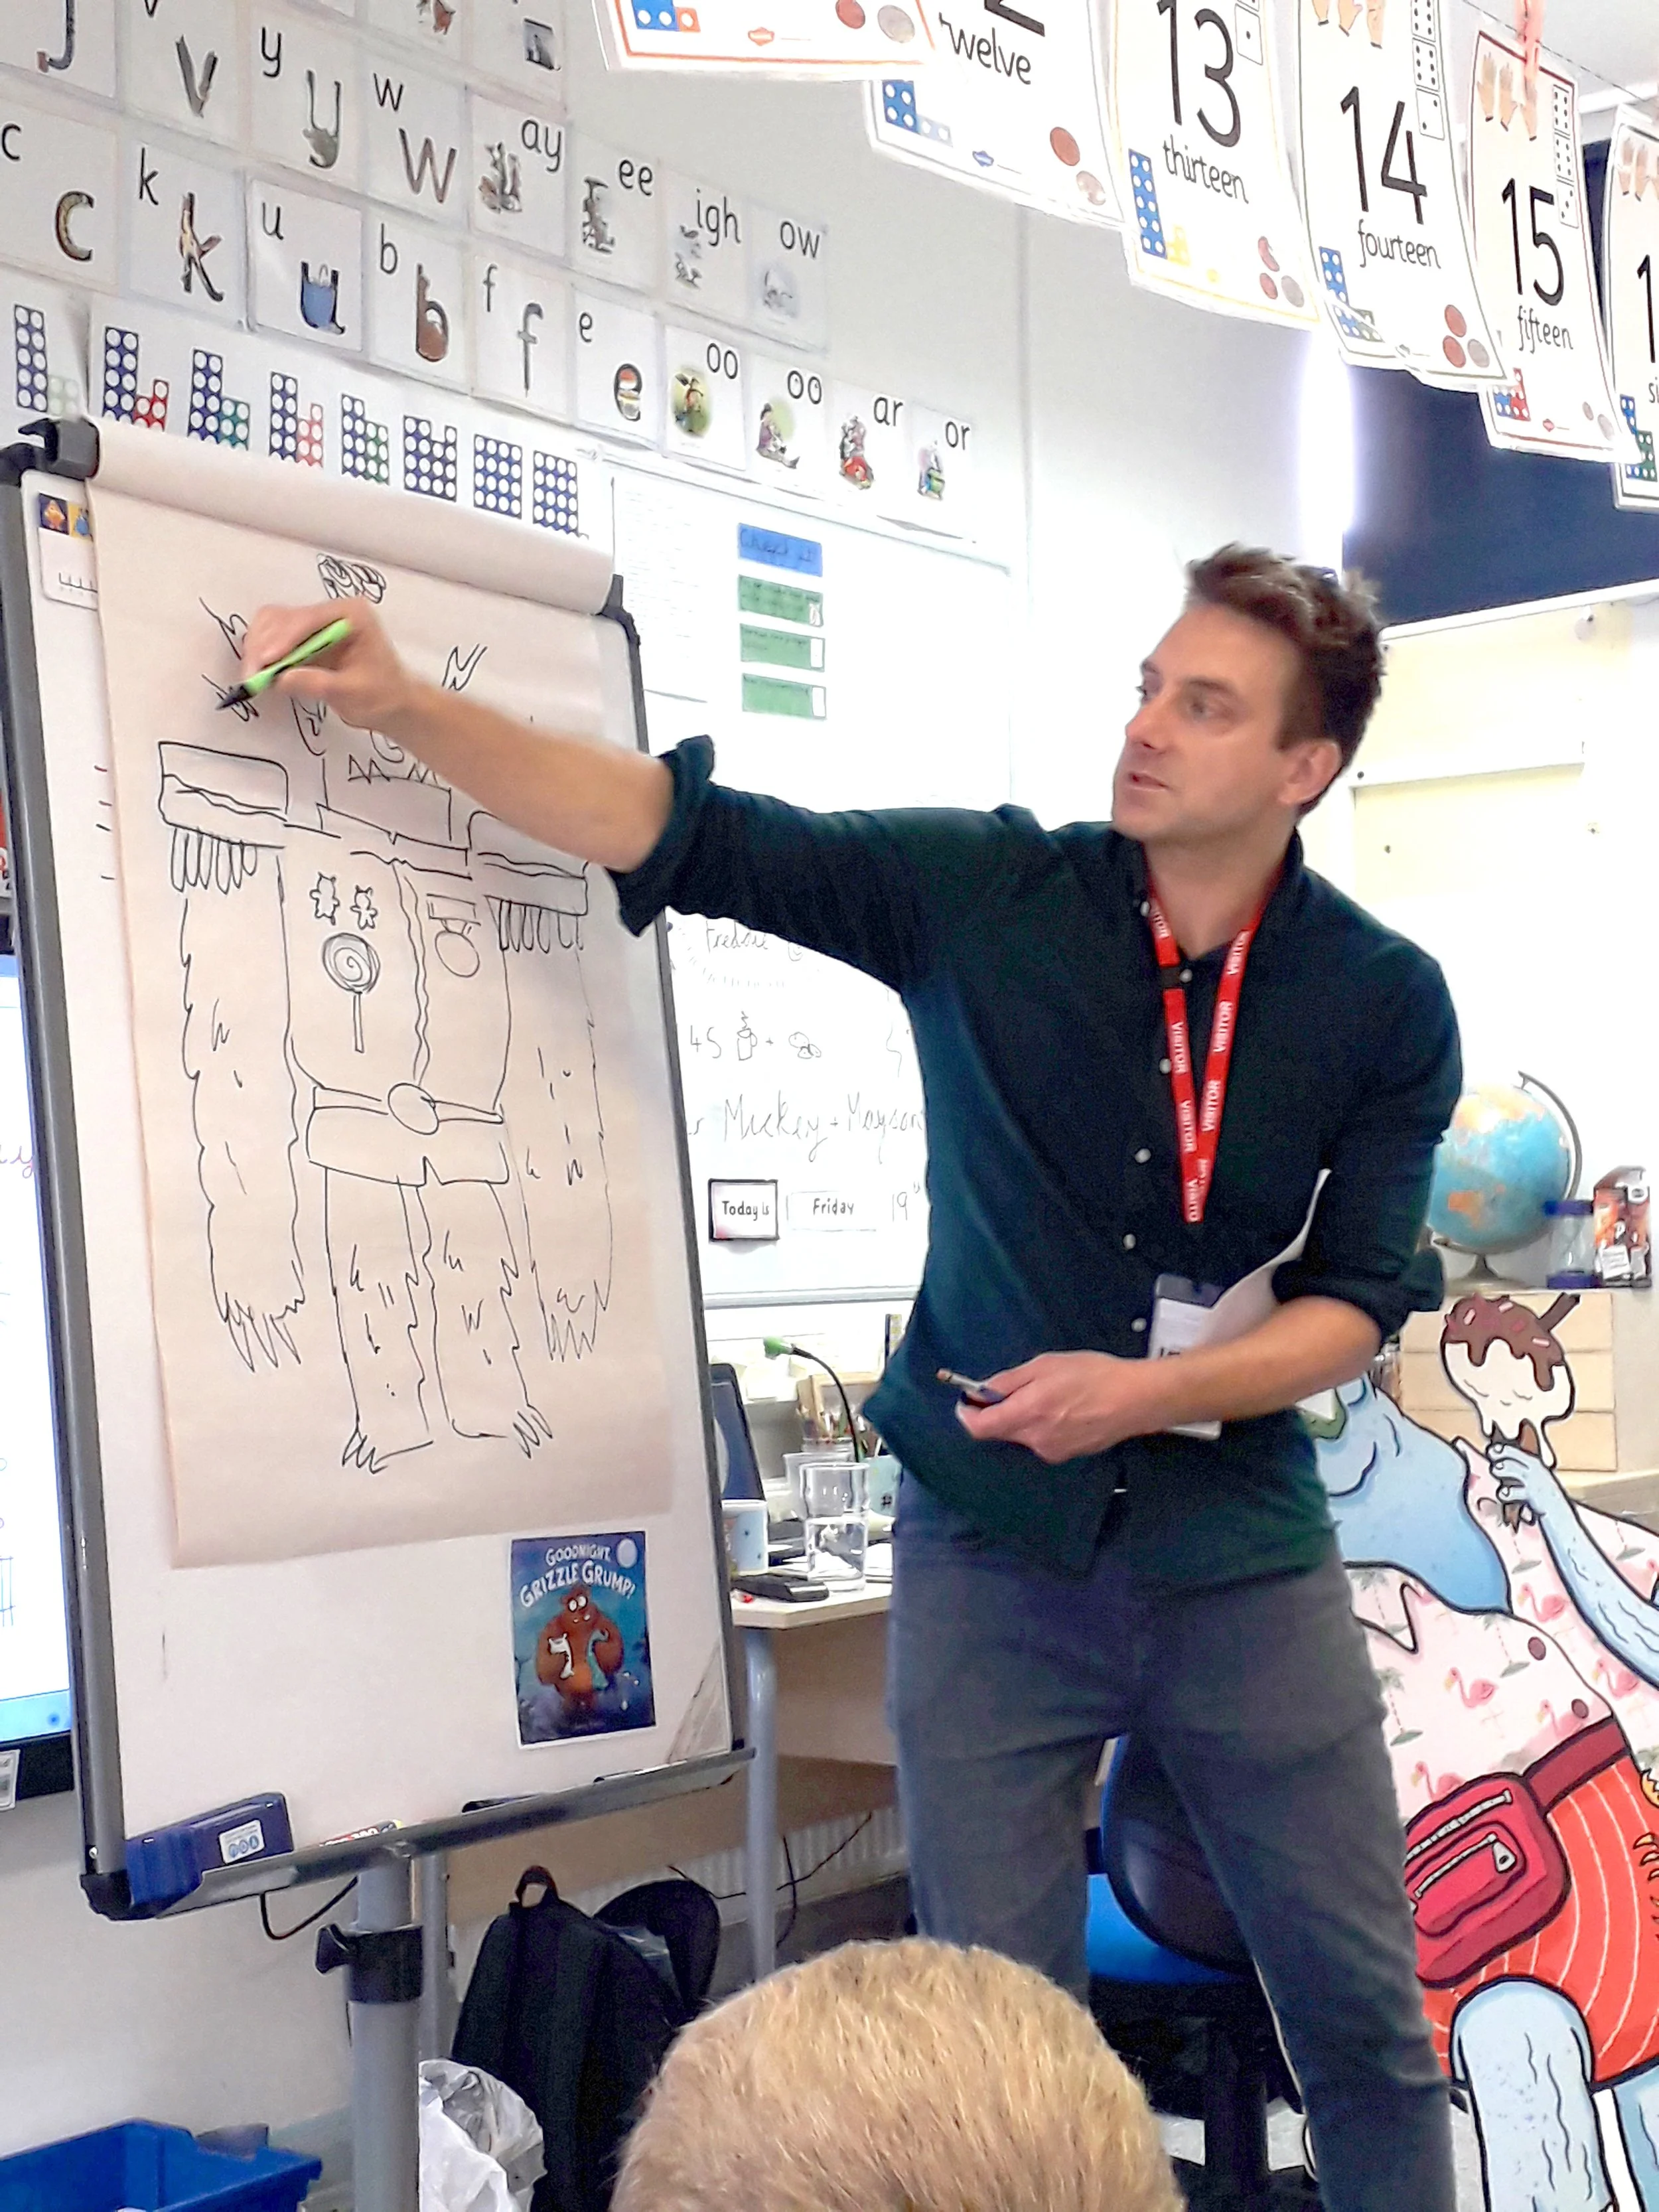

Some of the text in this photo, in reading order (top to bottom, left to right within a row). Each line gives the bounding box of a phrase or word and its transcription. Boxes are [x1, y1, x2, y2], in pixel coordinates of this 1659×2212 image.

[262, 27, 281, 78] y
[1156, 0, 1241, 147] 13
[374, 72, 403, 111] w
[521, 119, 562, 173] ay
[1162, 134, 1249, 204] thirteen
[1340, 86, 1427, 224] 14
[139, 147, 159, 206] k
[618, 159, 654, 196] ee
[262, 202, 284, 240] u
[695, 188, 741, 246] igh
[780, 220, 821, 259] ow
[380, 222, 398, 274] b
[1358, 219, 1441, 269] fourteen
[1502, 178, 1565, 307] 15
[482, 263, 498, 313] f
[579, 313, 593, 342] e
[1517, 305, 1574, 354] fifteen
[706, 343, 739, 380] oo
[787, 369, 823, 405] oo
[873, 396, 904, 427] ar
[945, 421, 970, 451] or
[1171, 1021, 1188, 1075] VISITOR
[722, 1200, 770, 1221] Today is
[813, 1197, 855, 1216] Friday
[520, 1560, 636, 1607] GRIZZLE GRUMP!
